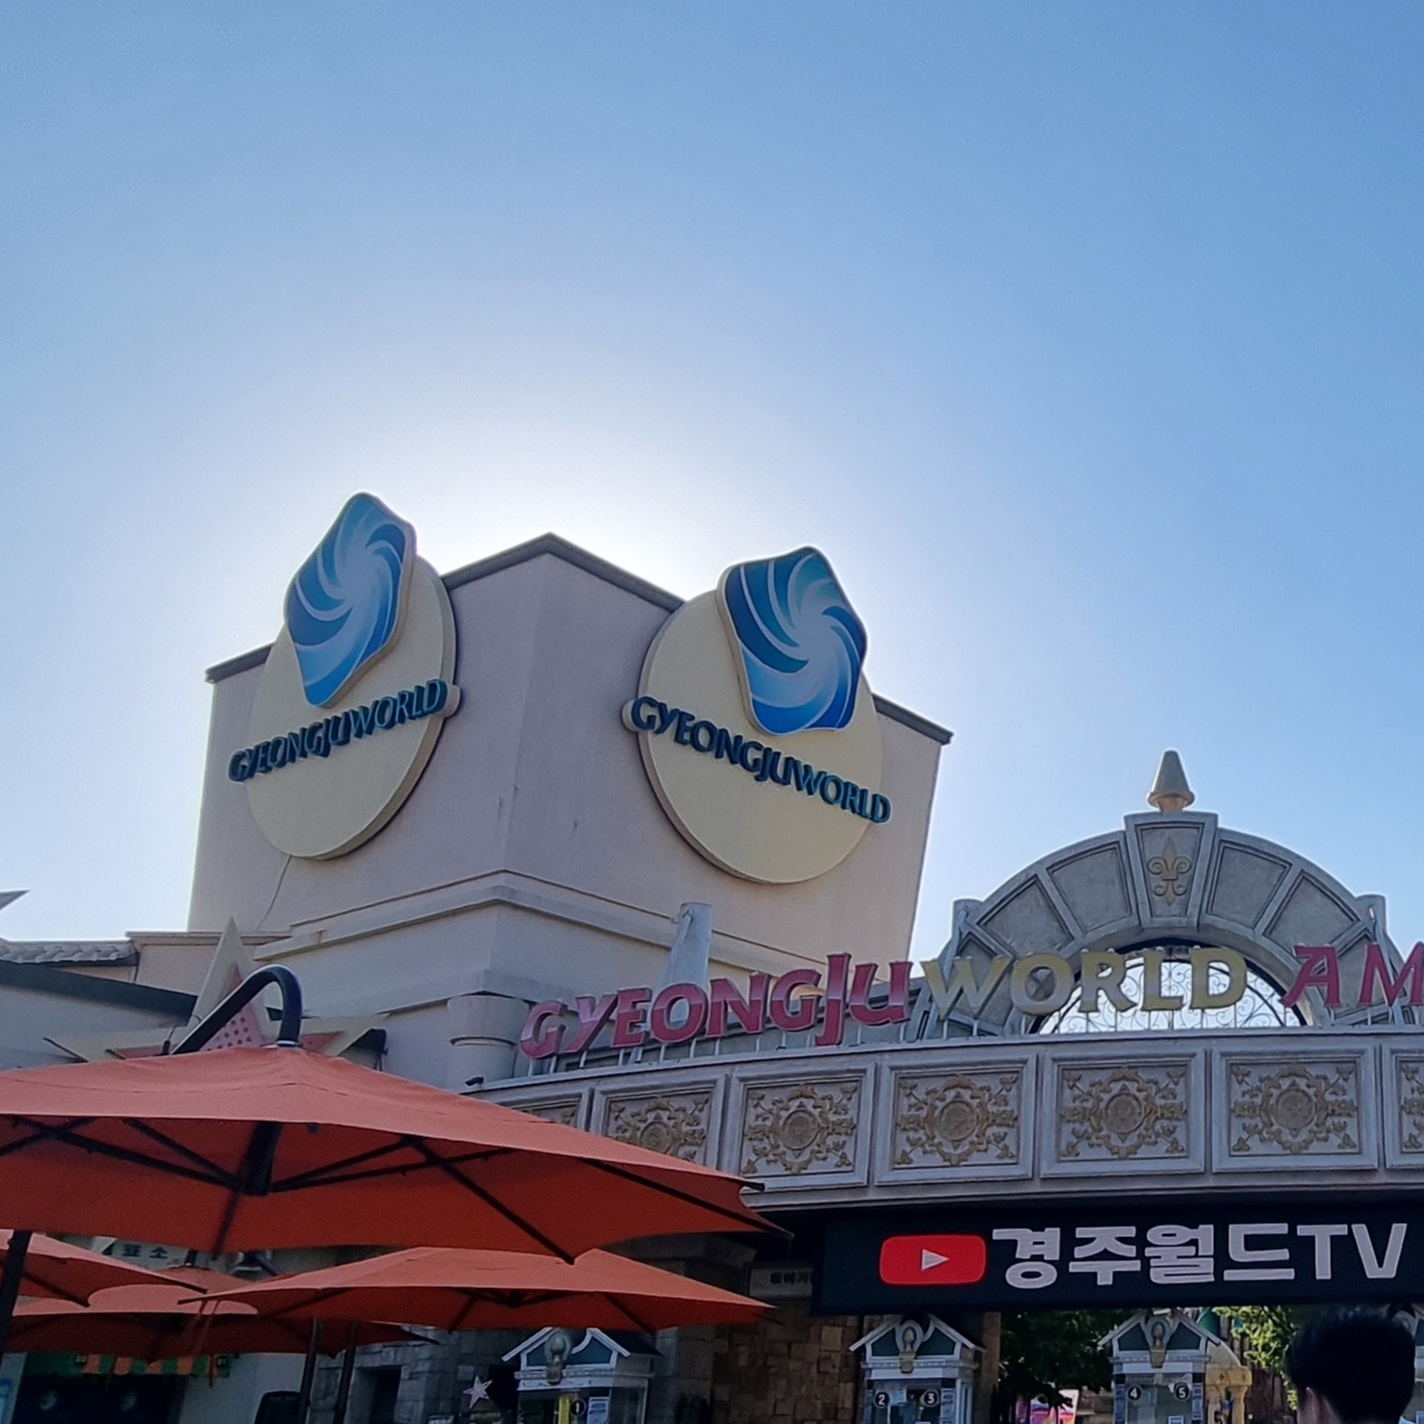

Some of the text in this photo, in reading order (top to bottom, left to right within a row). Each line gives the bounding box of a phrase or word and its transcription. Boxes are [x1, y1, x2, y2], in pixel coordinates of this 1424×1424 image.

[228, 679, 449, 783] GYEONGJUWORLD
[631, 696, 891, 824] GYEONGJUWORLD
[519, 952, 914, 1060] GYEONGJU
[919, 945, 1247, 1018] WORLD
[103, 1243, 168, 1259] 표소
[992, 1222, 1408, 1289] 경주월드TV
[878, 1393, 886, 1406] 2
[927, 1393, 935, 1405] 3
[1129, 1387, 1138, 1399] 4
[1178, 1387, 1187, 1399] 5
